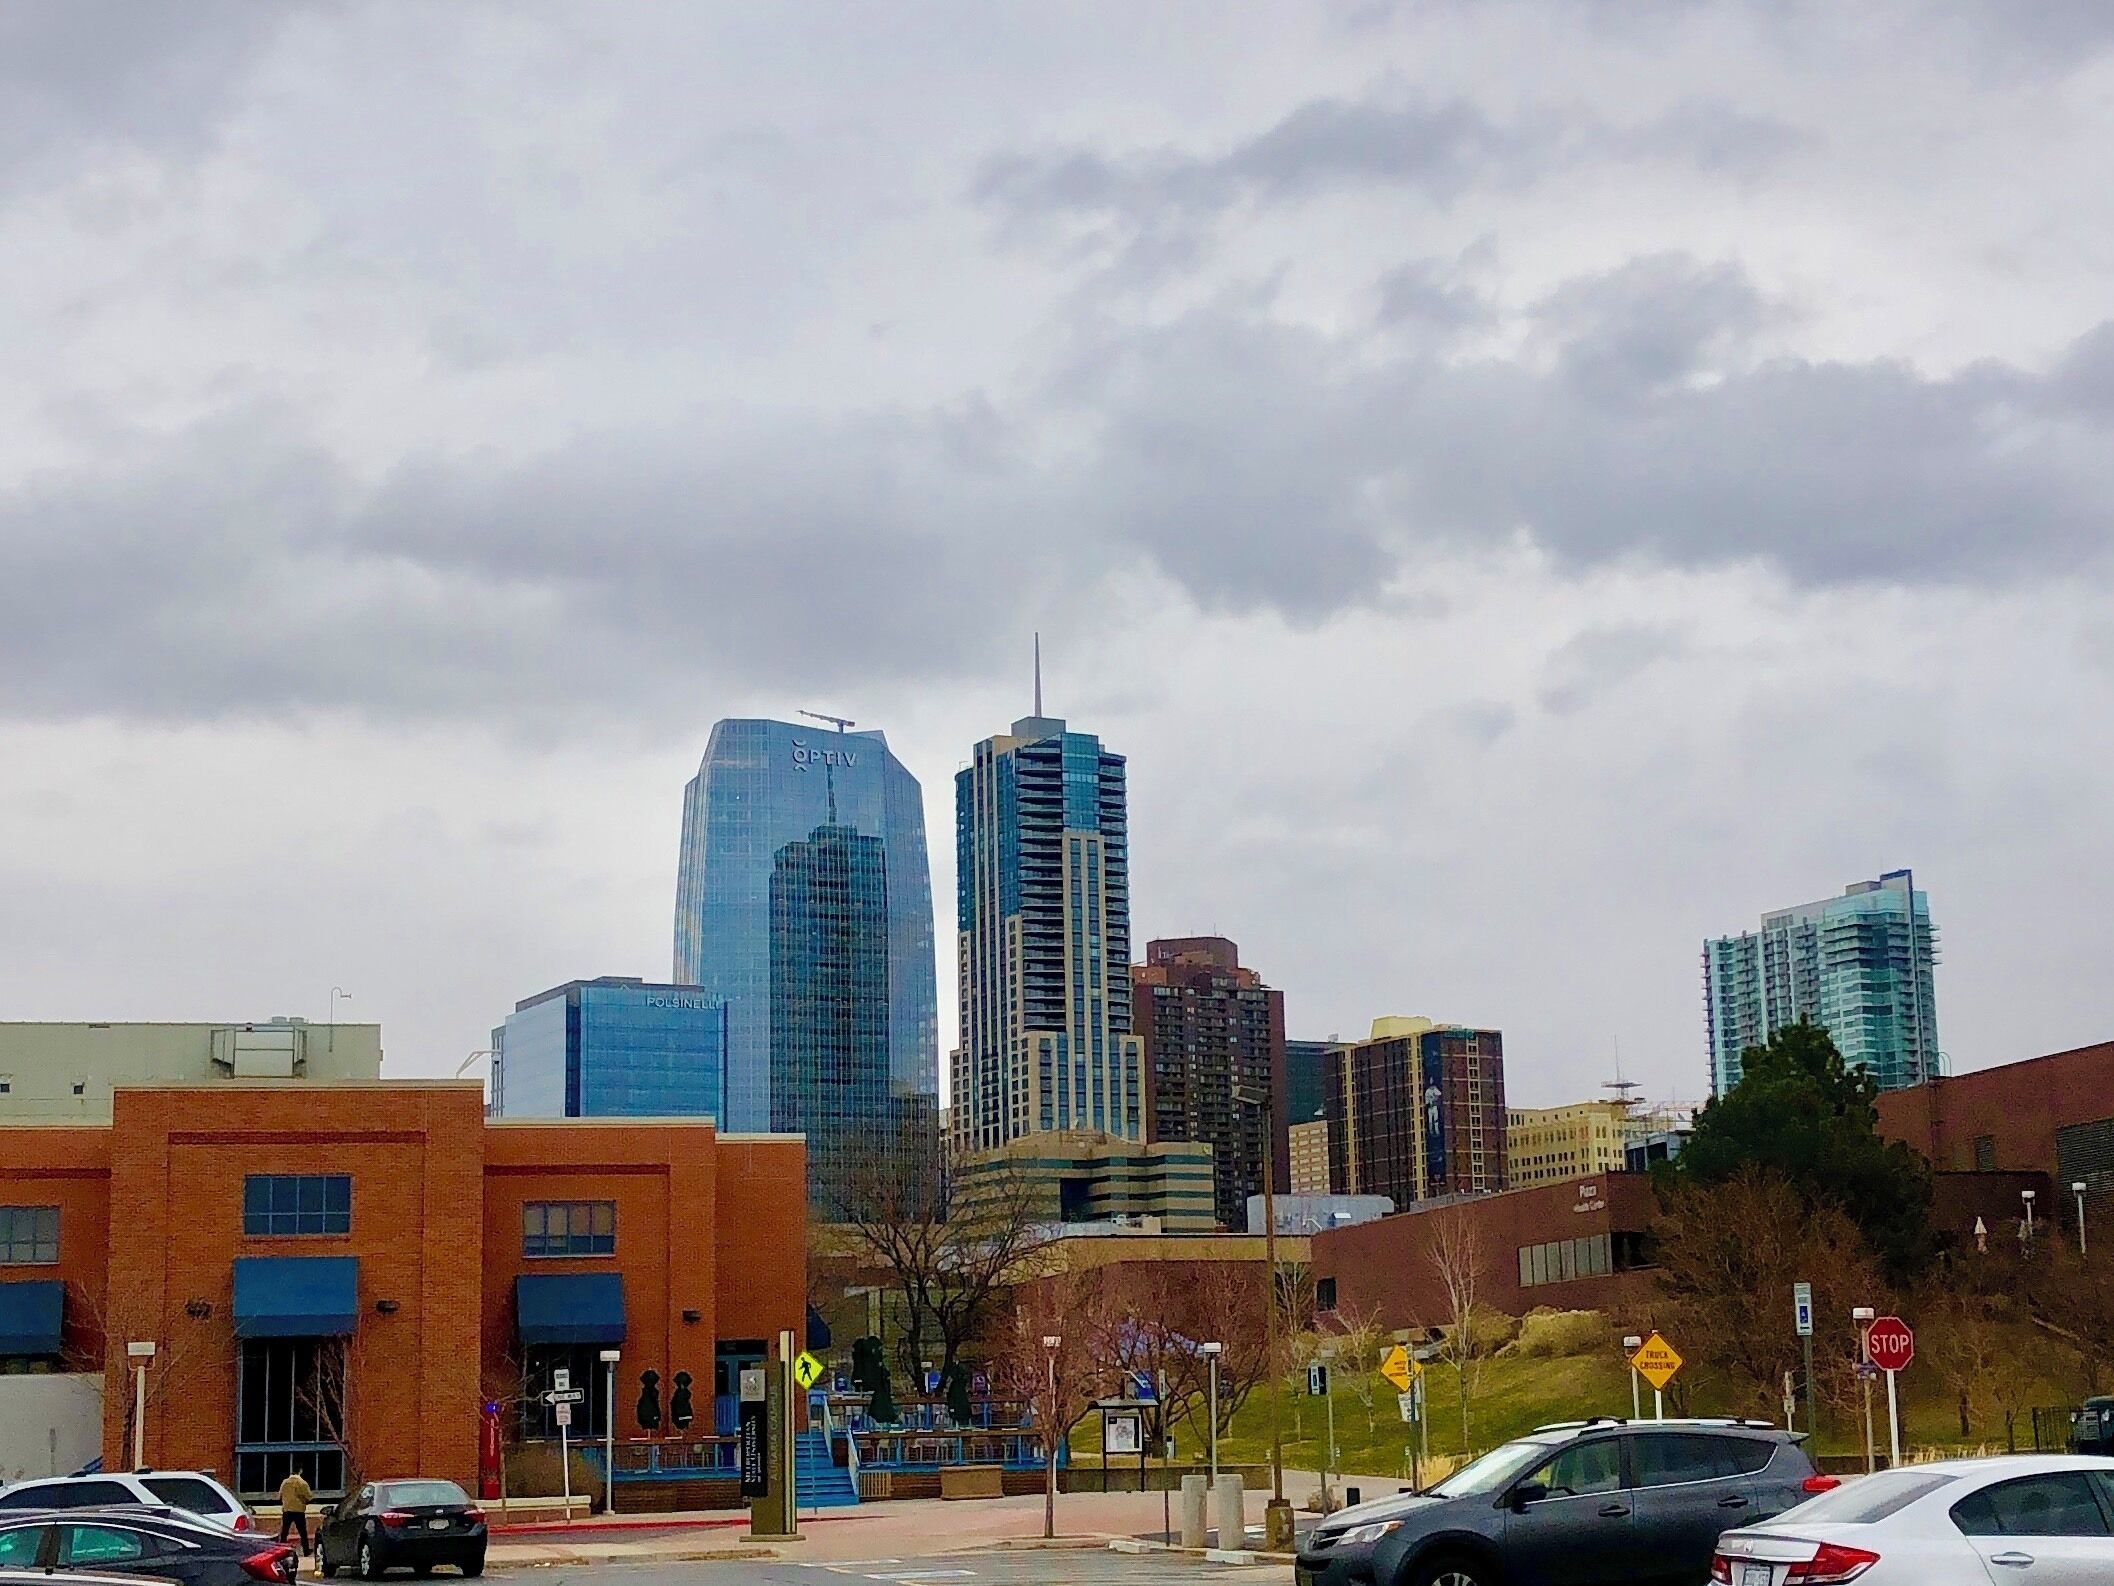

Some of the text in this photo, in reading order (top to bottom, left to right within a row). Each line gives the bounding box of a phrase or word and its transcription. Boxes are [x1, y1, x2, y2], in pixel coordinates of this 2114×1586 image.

[793, 746, 857, 768] OPTIV
[646, 997, 720, 1010] POLSINELLI
[1871, 1334, 1909, 1353] STOP
[1646, 1350, 1669, 1359] TRUCK
[1640, 1361, 1675, 1370] CROSSING
